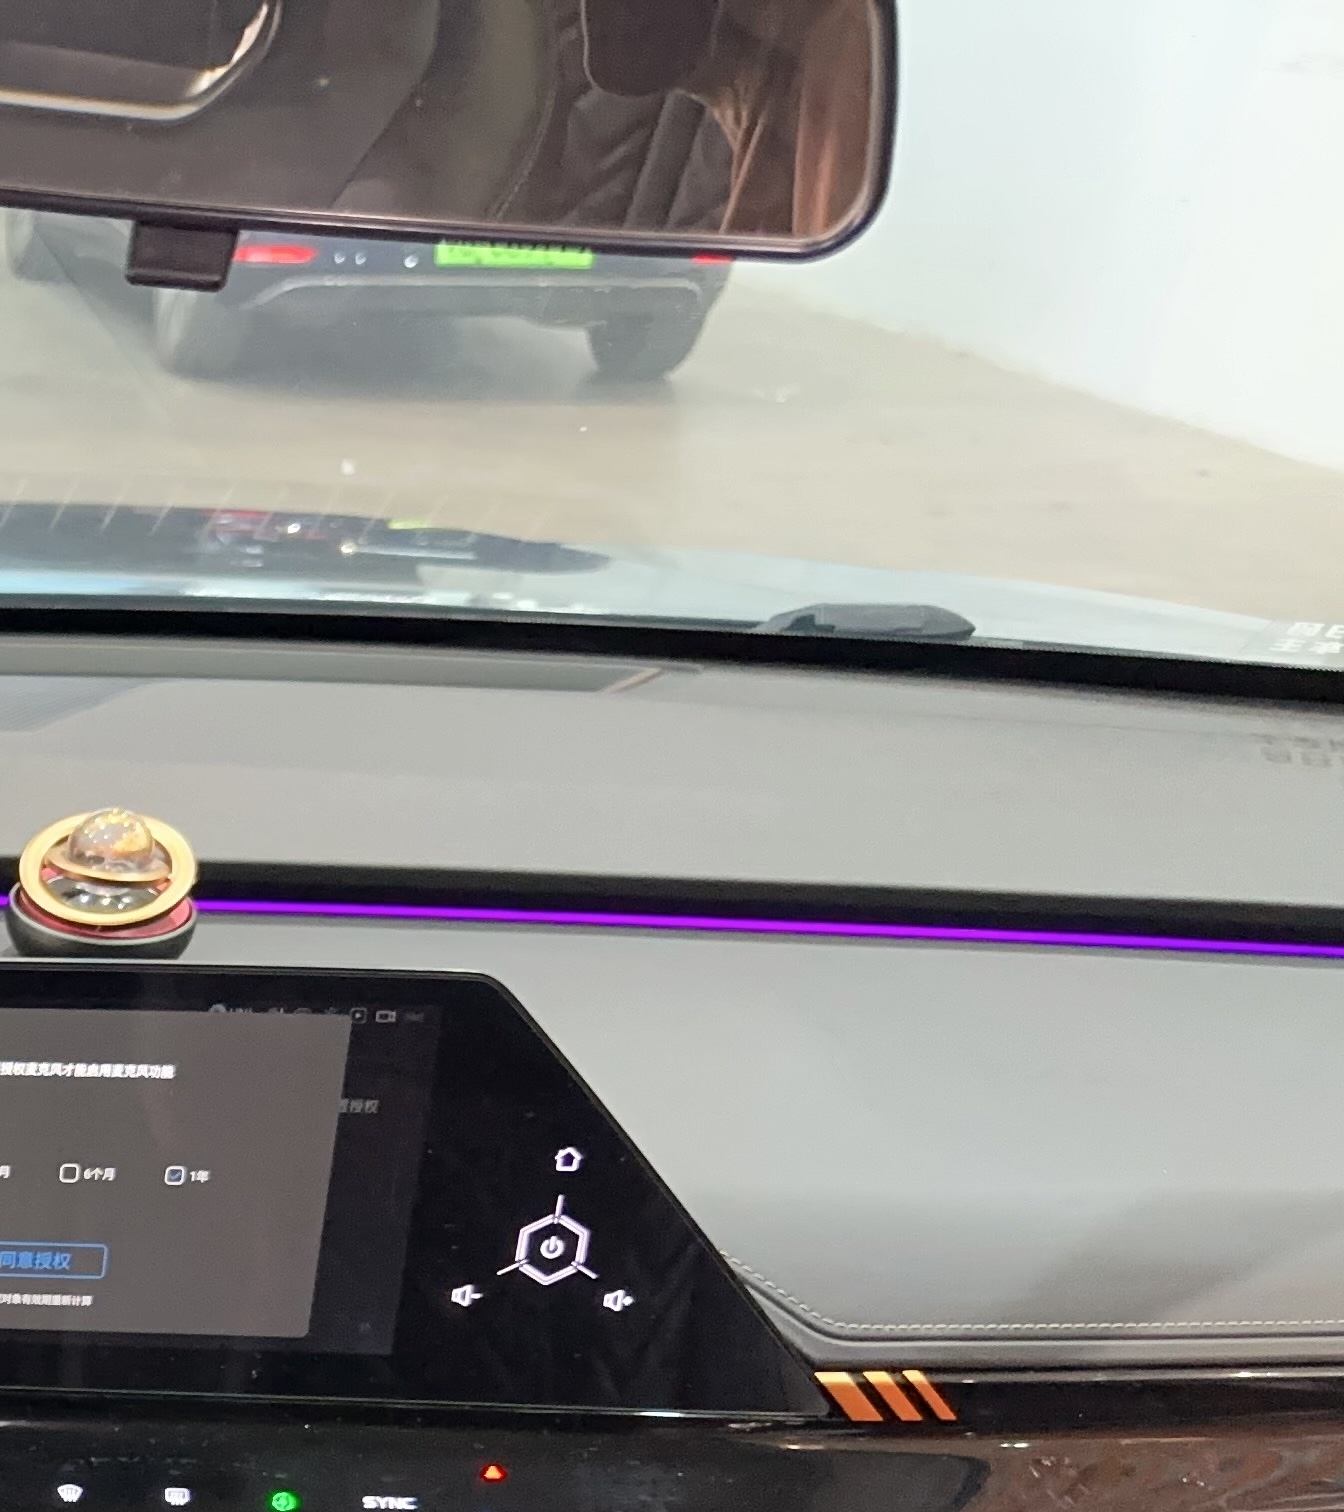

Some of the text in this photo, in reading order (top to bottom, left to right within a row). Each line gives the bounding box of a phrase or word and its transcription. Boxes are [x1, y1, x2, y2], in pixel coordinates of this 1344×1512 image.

[83, 1167, 116, 1182] 6个月
[189, 1169, 210, 1184] 1年
[361, 1496, 418, 1511] SYNC
